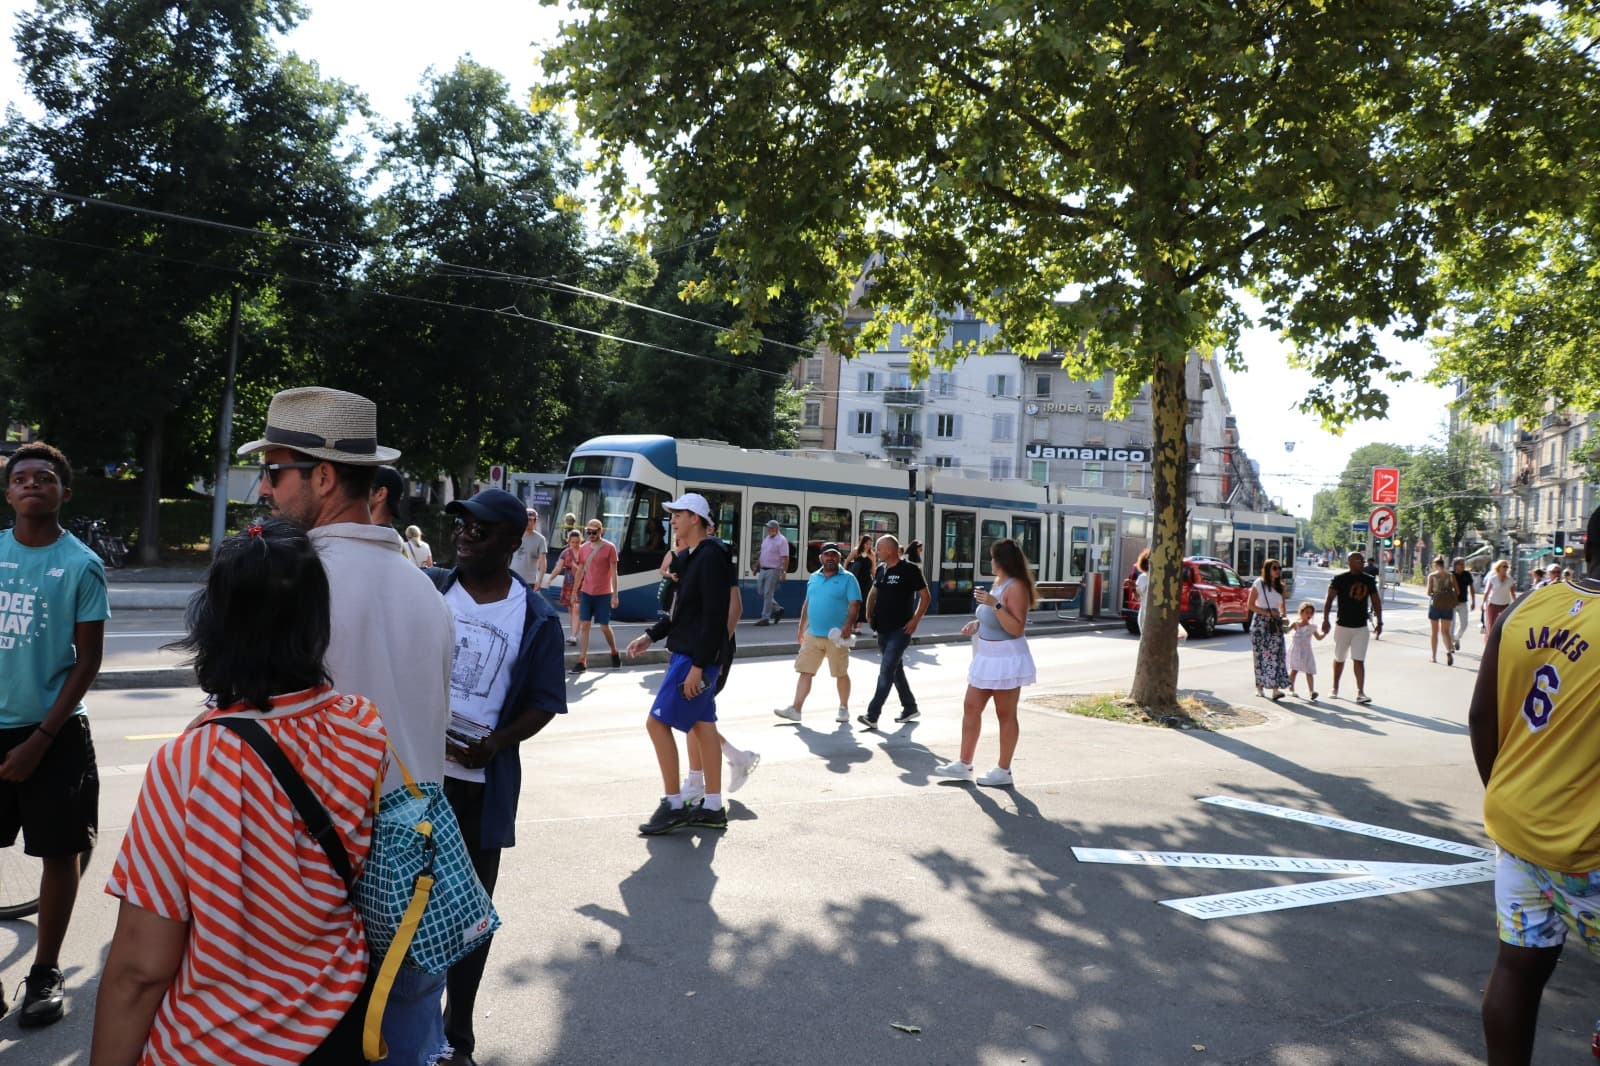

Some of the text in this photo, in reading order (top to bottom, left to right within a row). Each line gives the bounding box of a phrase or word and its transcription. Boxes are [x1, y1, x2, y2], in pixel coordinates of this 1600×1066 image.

[1042, 402, 1082, 413] IRIDEA
[1026, 444, 1145, 462] Jamarico
[1526, 626, 1590, 662] JAMES
[1522, 663, 1561, 733] 6
[1131, 853, 1280, 869] ROTOLARE
